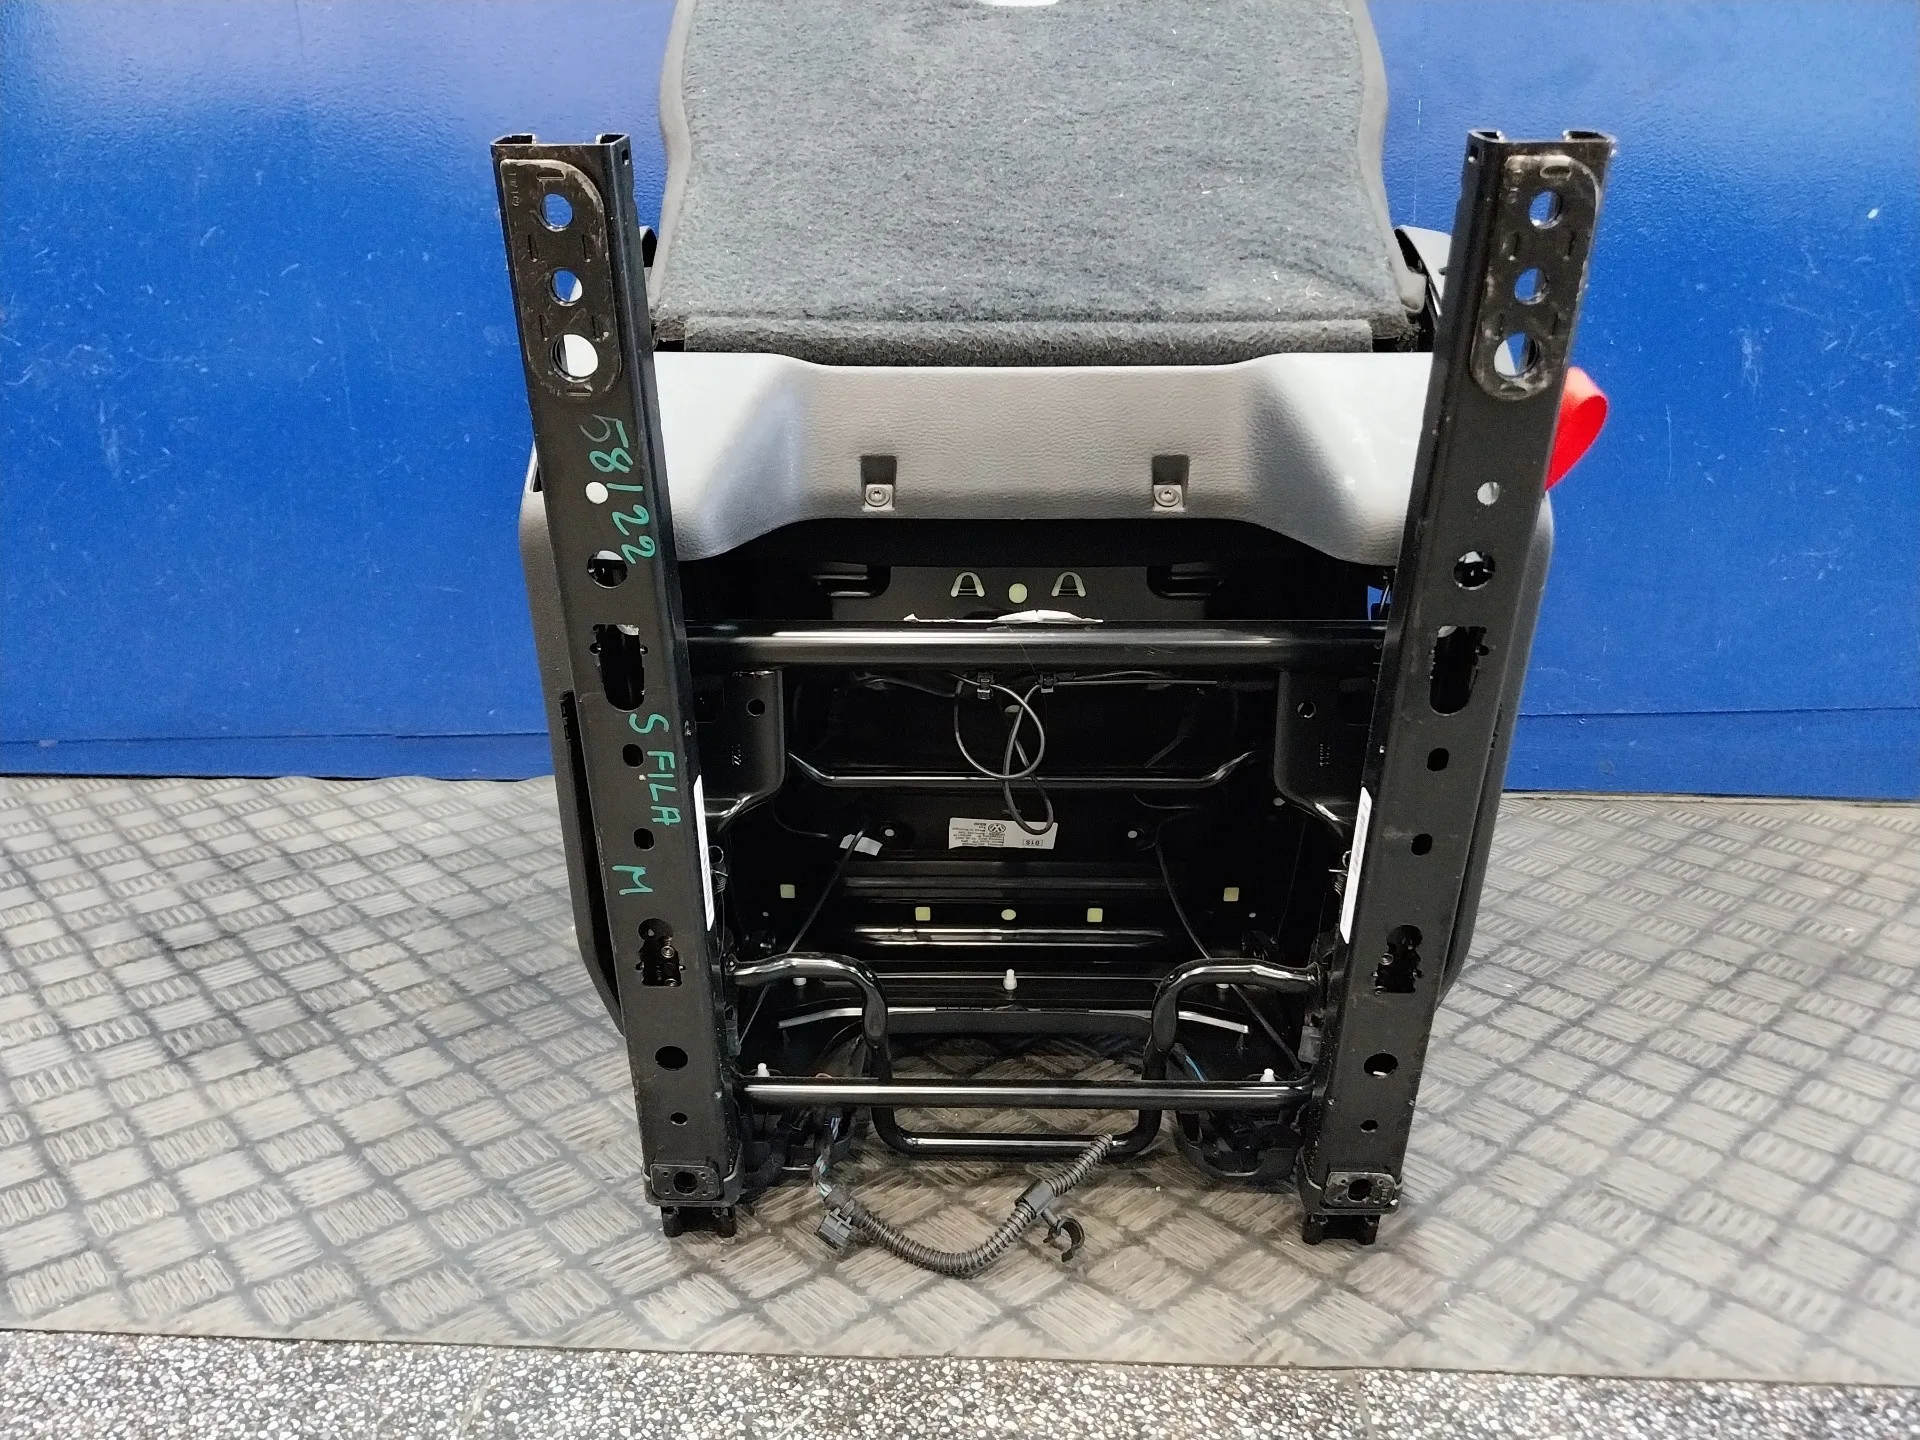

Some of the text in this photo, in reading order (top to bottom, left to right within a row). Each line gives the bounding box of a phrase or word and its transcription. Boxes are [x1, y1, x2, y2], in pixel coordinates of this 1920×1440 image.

[579, 413, 660, 564] 58122
[646, 748, 683, 826] FILA
[613, 863, 653, 895] M
